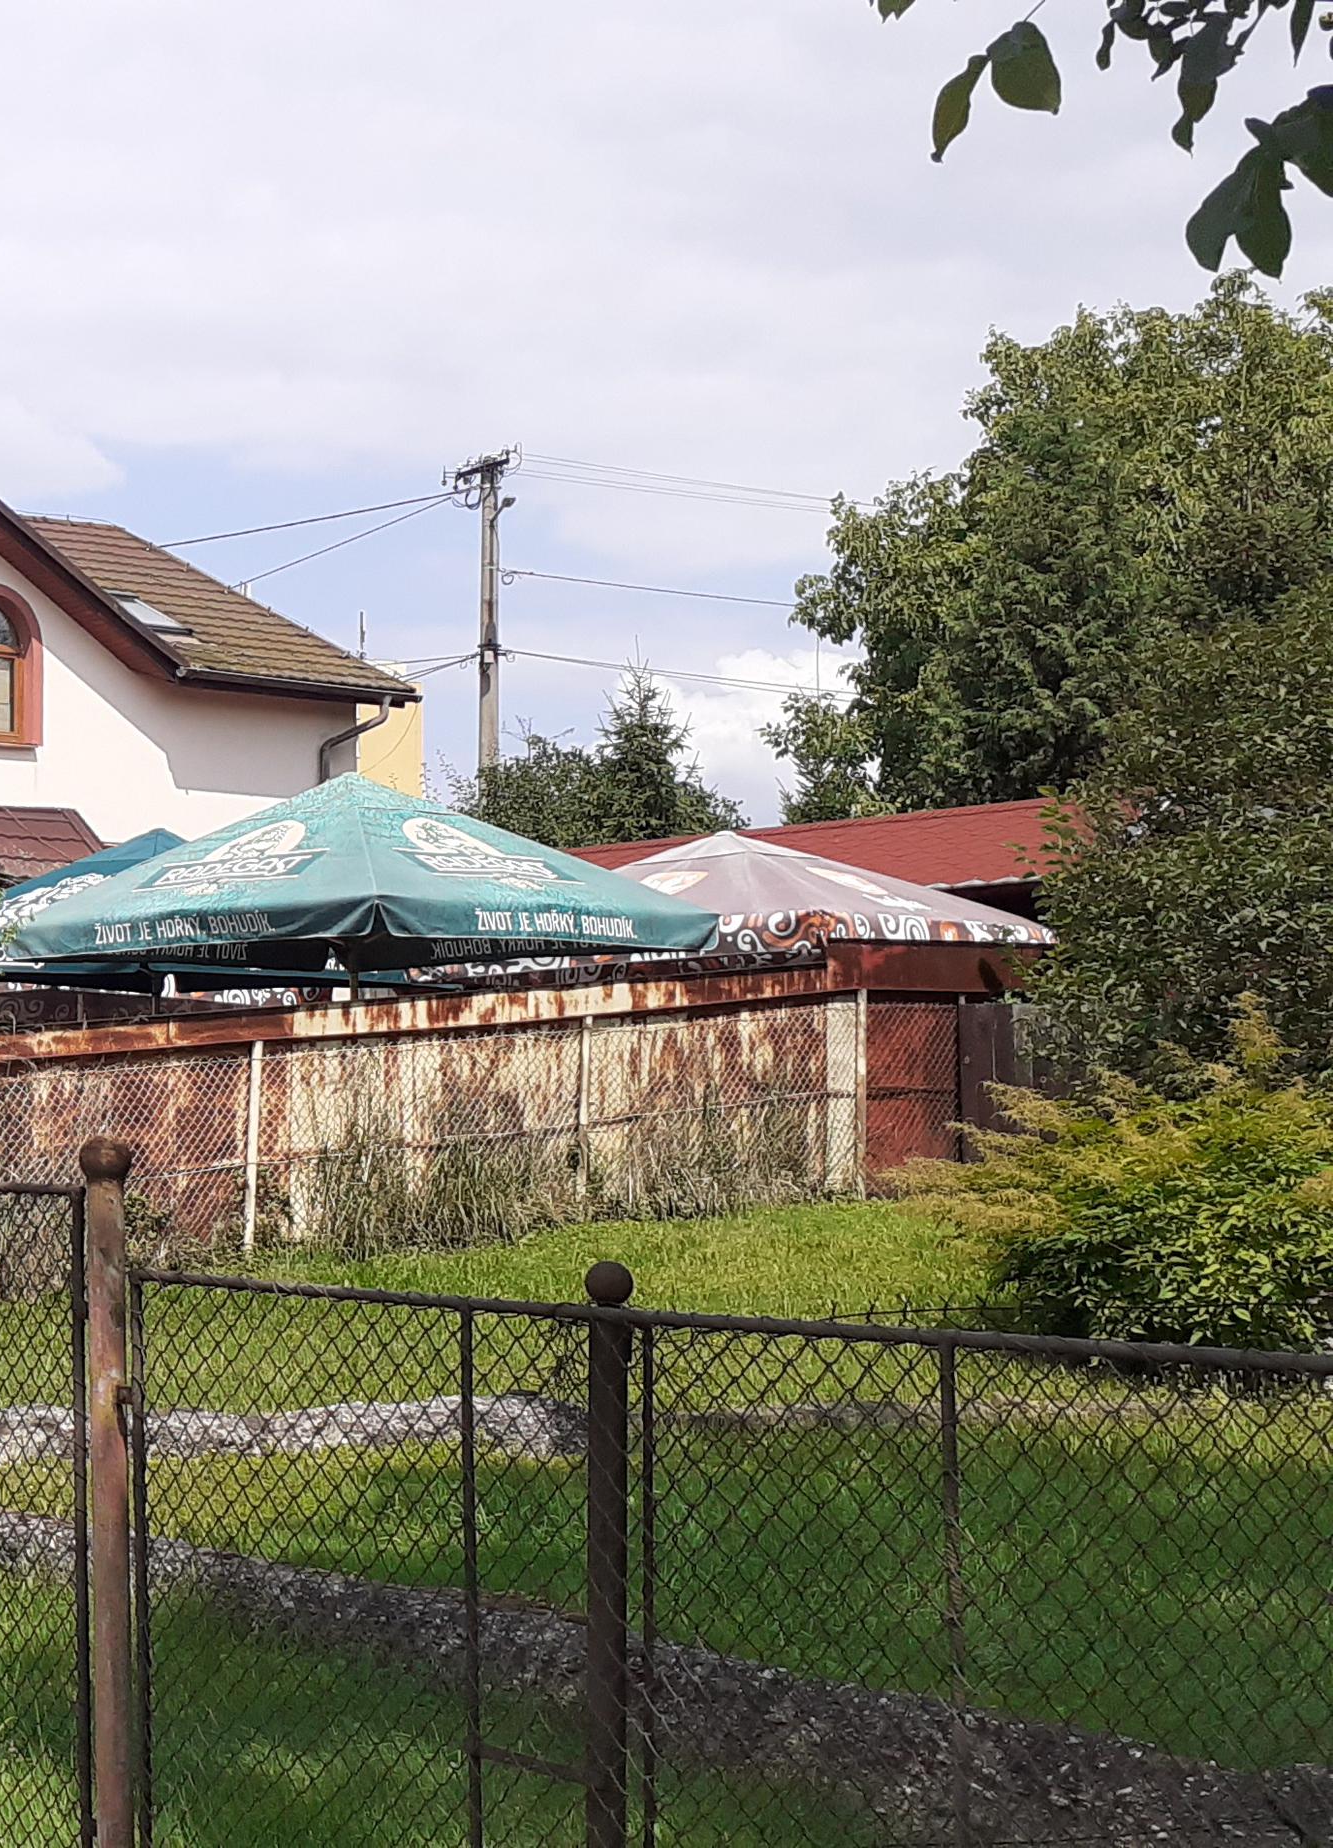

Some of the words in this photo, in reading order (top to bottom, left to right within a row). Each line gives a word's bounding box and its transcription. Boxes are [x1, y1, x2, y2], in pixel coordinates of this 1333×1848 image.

[154, 854, 313, 885] RADEGAST
[415, 854, 558, 879] RADEGAST
[475, 908, 513, 931] ŽIVOT
[518, 912, 533, 932] JE
[94, 923, 131, 945] ŽIVOT
[138, 921, 152, 941] JE
